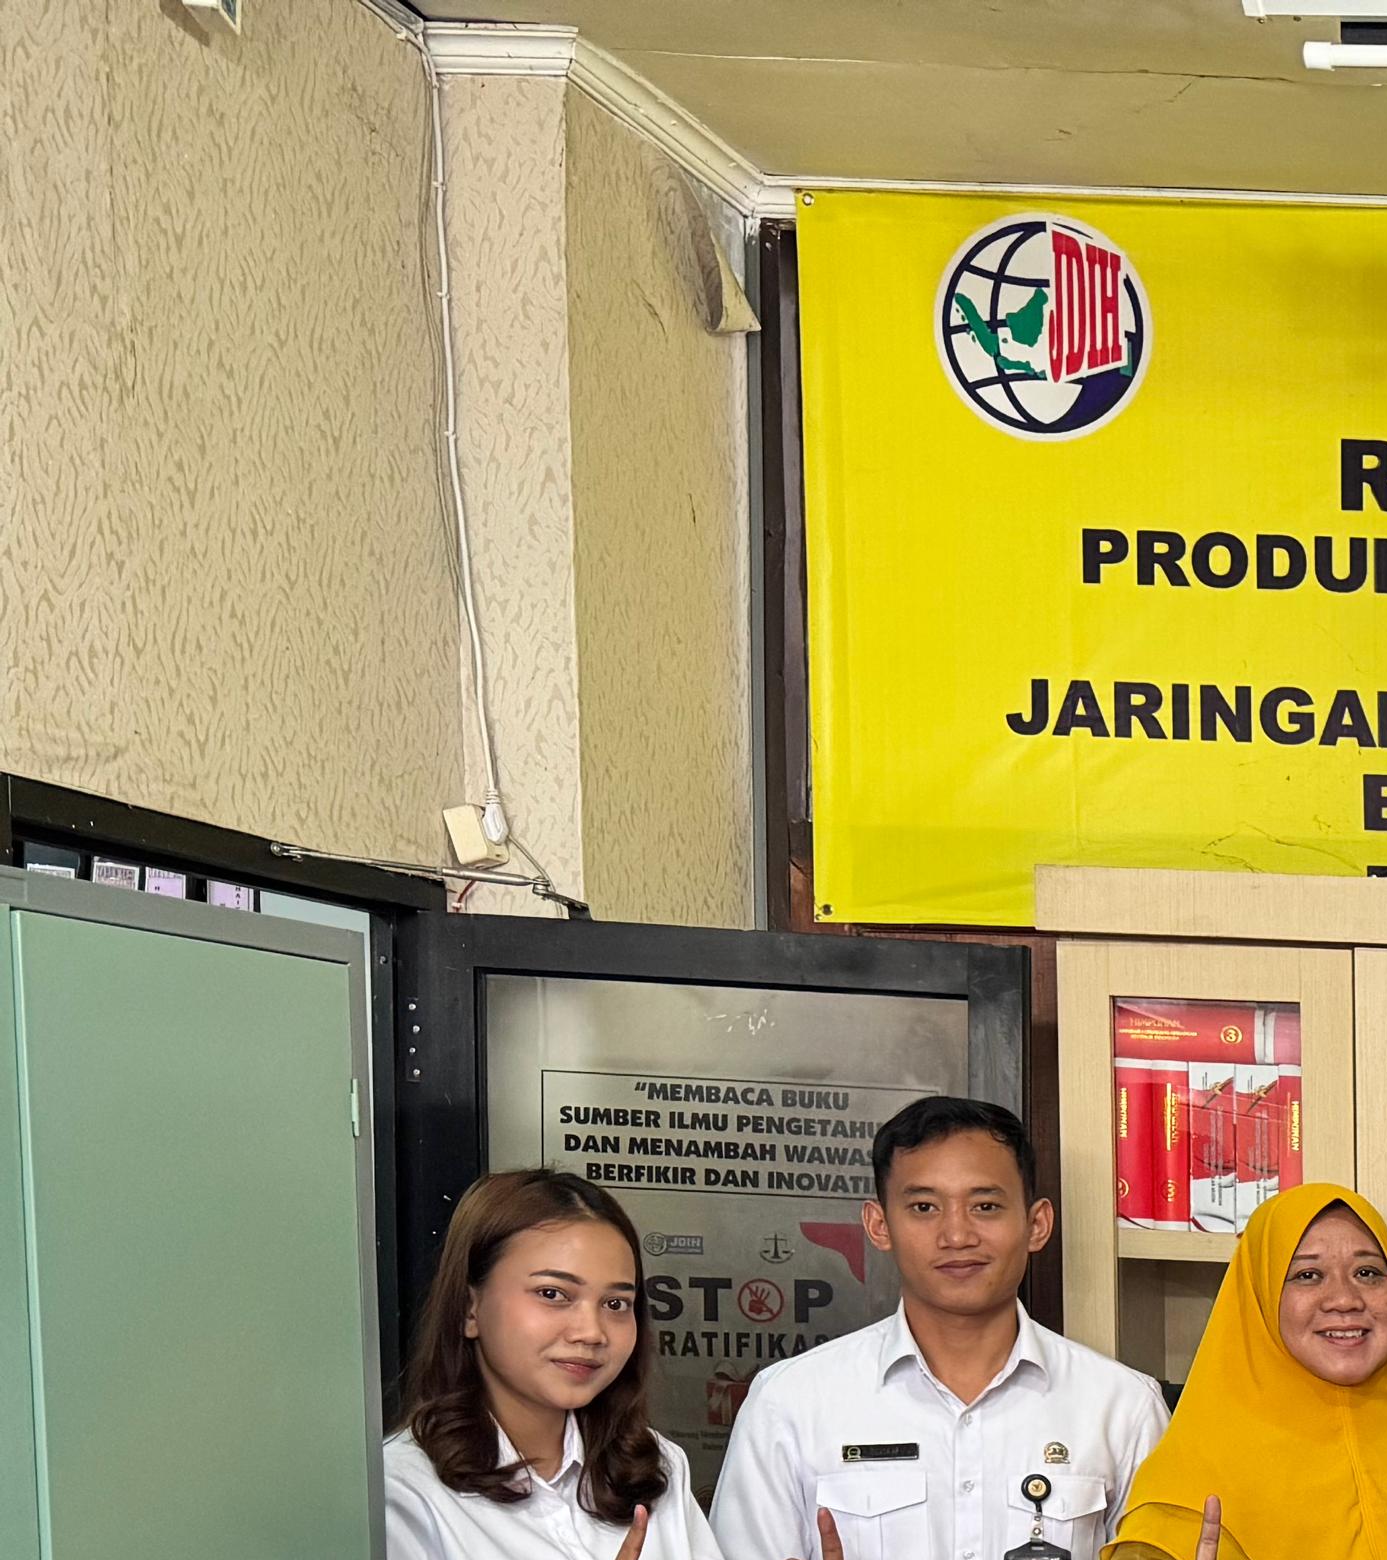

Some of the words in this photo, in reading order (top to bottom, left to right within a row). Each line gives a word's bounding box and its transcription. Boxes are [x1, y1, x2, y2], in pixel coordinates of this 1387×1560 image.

[1049, 230, 1122, 383] JDIH
[781, 1090, 849, 1111] BUKU
[559, 1105, 660, 1129] SUMBER
[668, 1112, 728, 1132] ILMU
[564, 1134, 620, 1154] DAN
[628, 1137, 776, 1161] MENAMBAH
[586, 1163, 696, 1185] BERFIKIR
[704, 1169, 759, 1188] DAN
